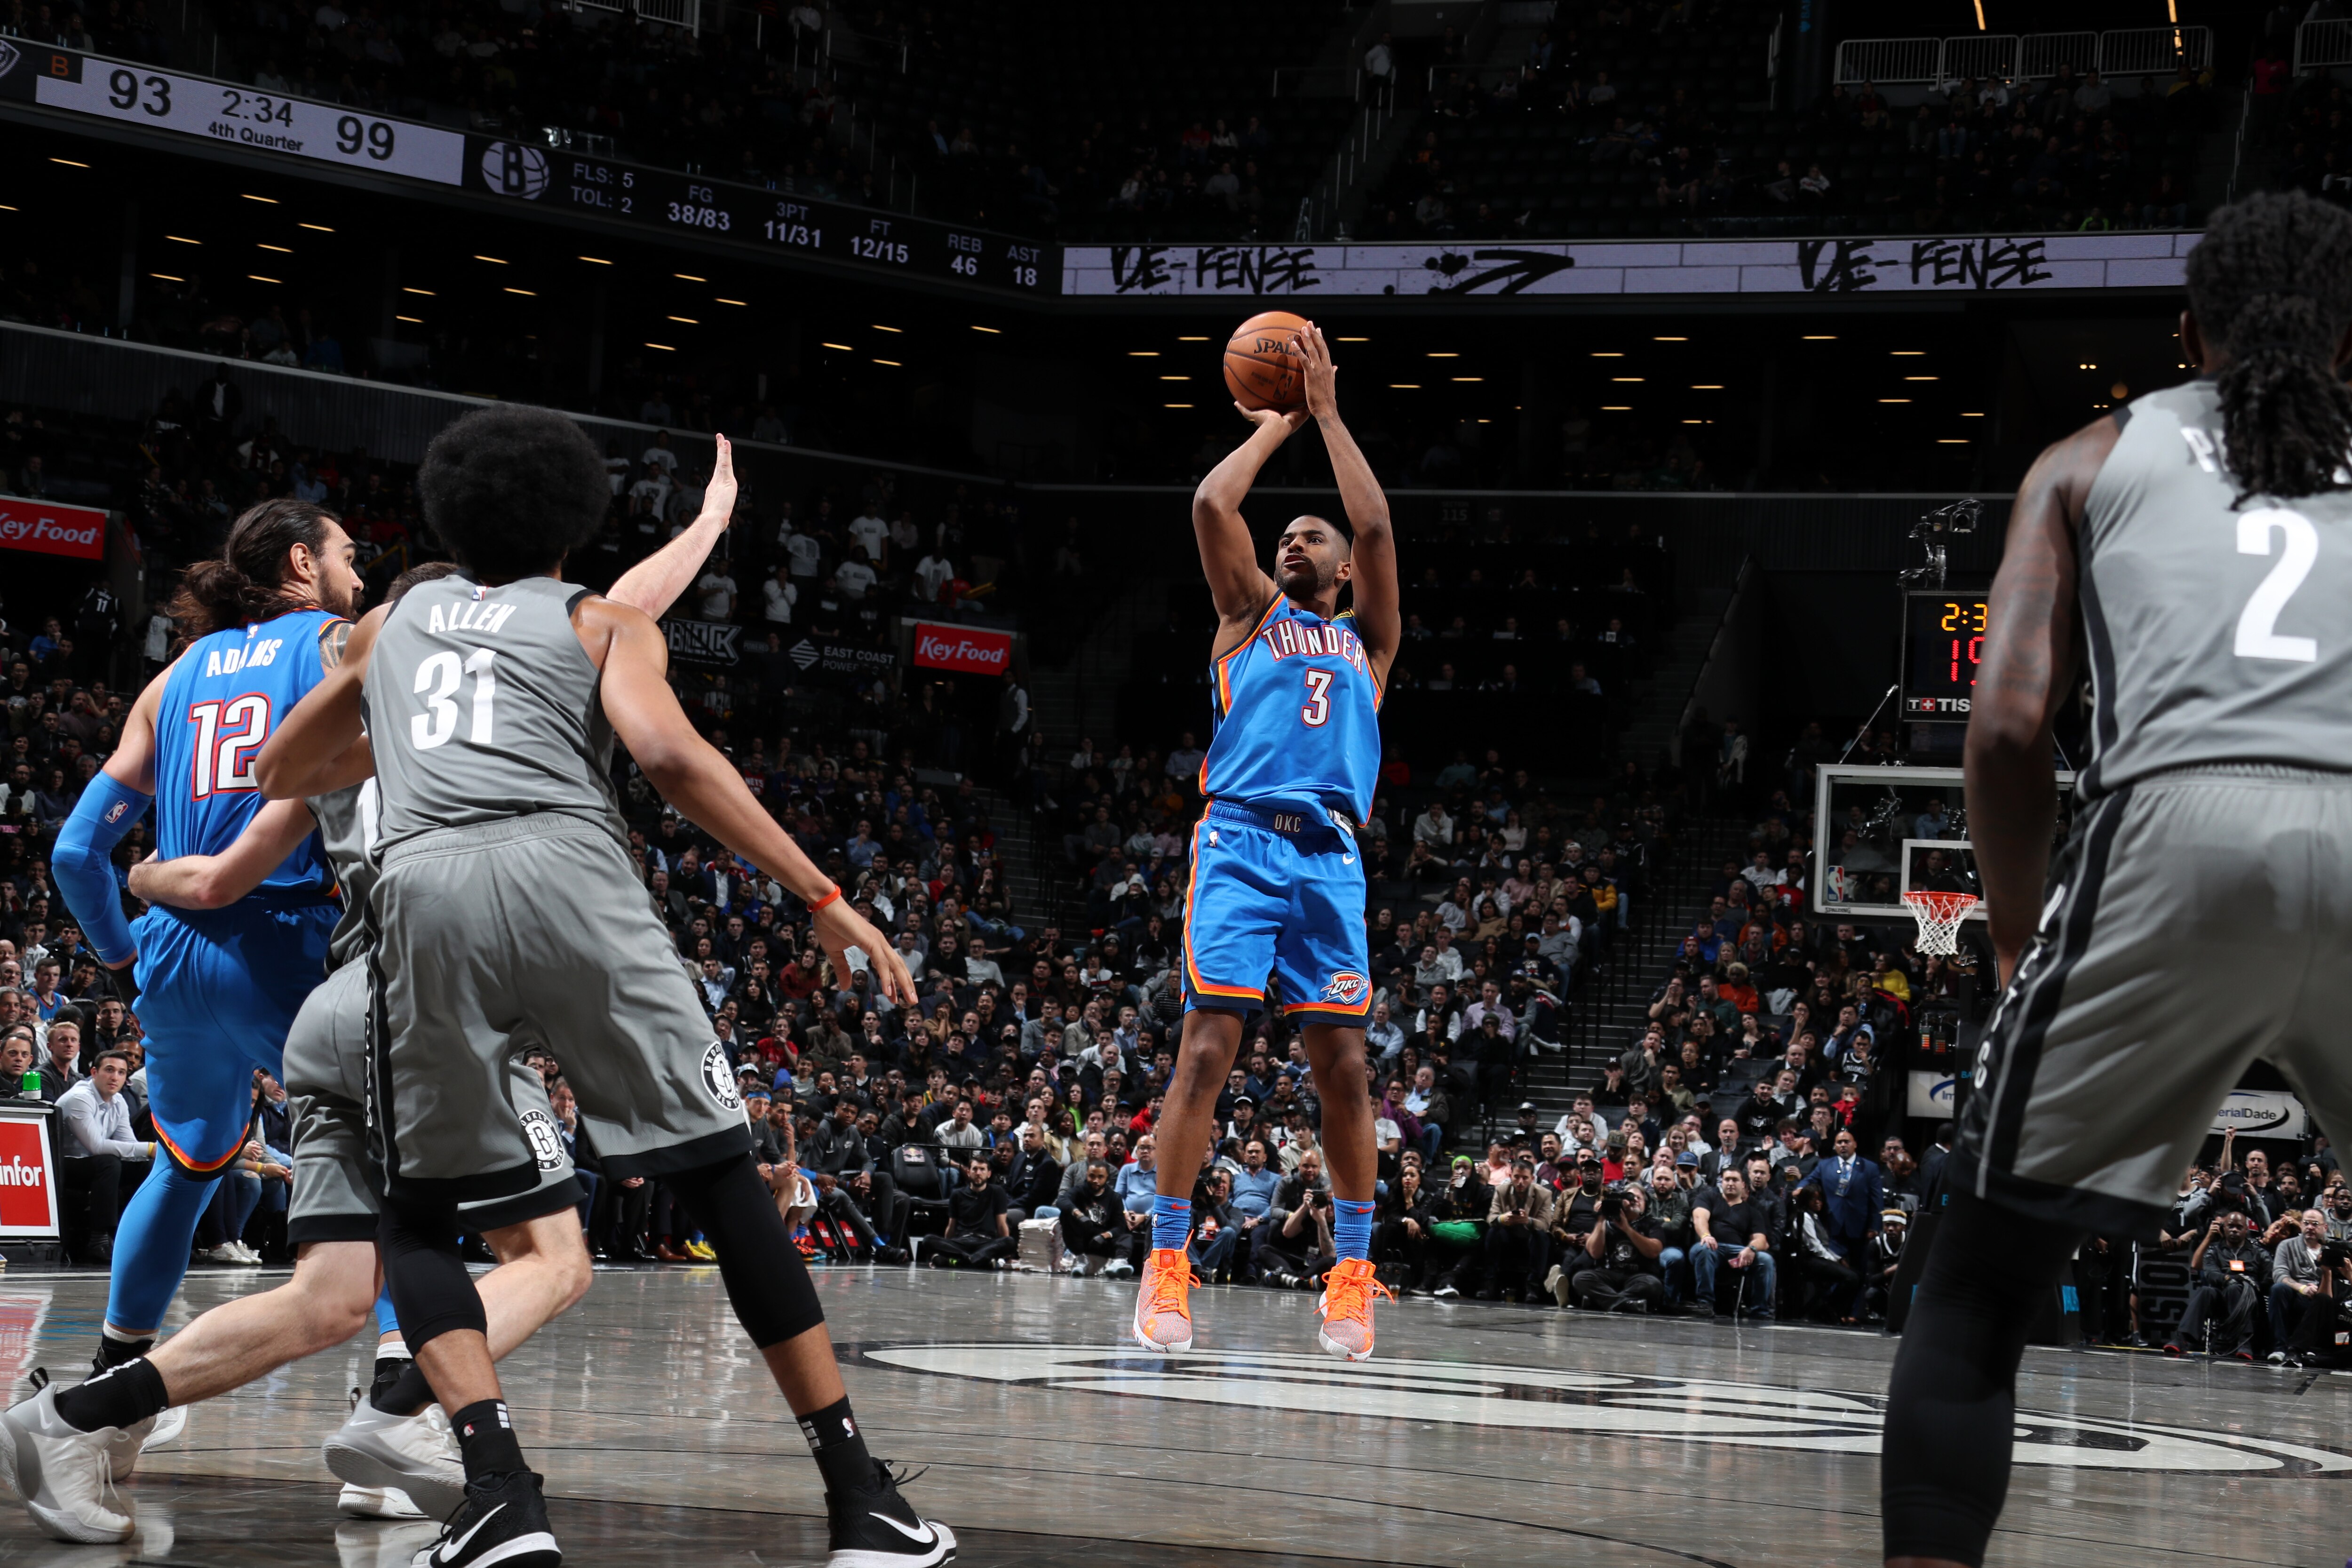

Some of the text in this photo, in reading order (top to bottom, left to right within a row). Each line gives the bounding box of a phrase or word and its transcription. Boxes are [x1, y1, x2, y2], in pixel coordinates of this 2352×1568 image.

[51, 56, 69, 76] B
[109, 69, 171, 117] 93
[222, 89, 294, 127] 2:34
[208, 120, 304, 152] 4th Quarter
[336, 116, 395, 161] 99
[573, 163, 634, 188] FLS: 5
[571, 187, 632, 213] TOL: 2
[689, 185, 713, 203] FG
[667, 202, 731, 231] 38/83
[777, 202, 808, 221] 3PT
[764, 221, 820, 248] 11/31
[870, 219, 891, 236] FT
[850, 236, 909, 263] 12/15
[948, 233, 982, 253] REB
[1007, 245, 1040, 263] AST
[951, 255, 977, 276] 46
[1014, 266, 1037, 286] 18
[1110, 246, 1320, 294] DE-FENSE
[1797, 239, 2052, 291] DE-FENSE
[1442, 509, 1468, 521] 115
[32, 517, 97, 545] Food
[2234, 508, 2319, 662] 2
[96, 597, 108, 613] 11
[429, 602, 517, 634] ALLEN
[206, 638, 283, 677] ADAMS
[823, 645, 895, 666] EAST COAST
[918, 637, 1005, 664] Key Food
[1260, 618, 1364, 676] THUNDER
[411, 647, 497, 750] 31
[1301, 668, 1335, 728] 3
[1937, 698, 1972, 712] TIS
[188, 691, 271, 800] 12
[1274, 813, 1302, 833] OKC
[1330, 979, 1359, 995] OKC
[0, 1155, 42, 1187] infor
[2179, 1211, 2185, 1227] 1
